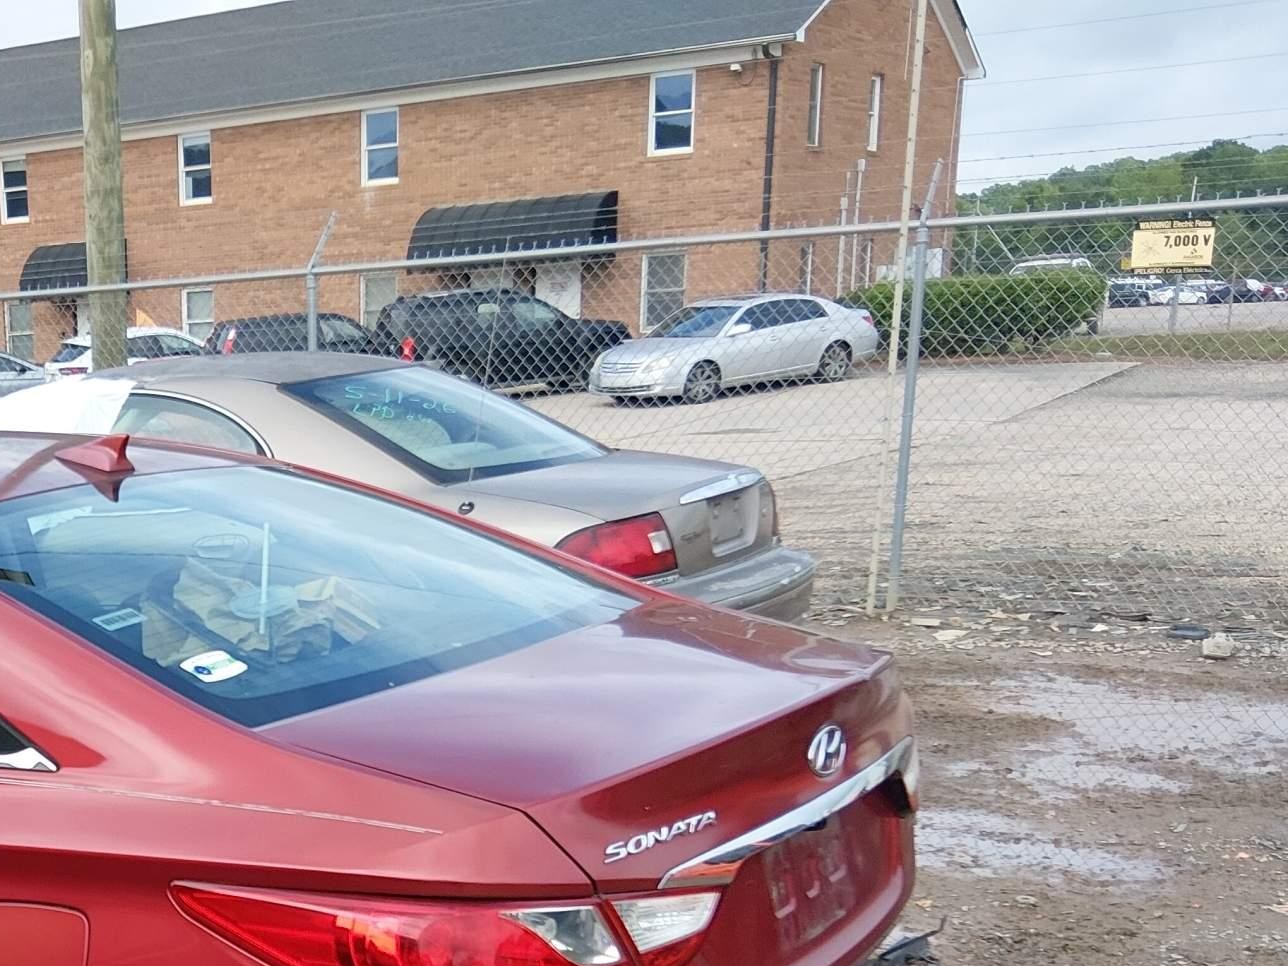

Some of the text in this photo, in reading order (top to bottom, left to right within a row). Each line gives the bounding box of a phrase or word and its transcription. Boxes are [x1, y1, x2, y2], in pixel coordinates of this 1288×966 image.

[1172, 220, 1194, 228] Electric
[1164, 234, 1211, 248] 7,000 V
[604, 810, 718, 864] SONATA
